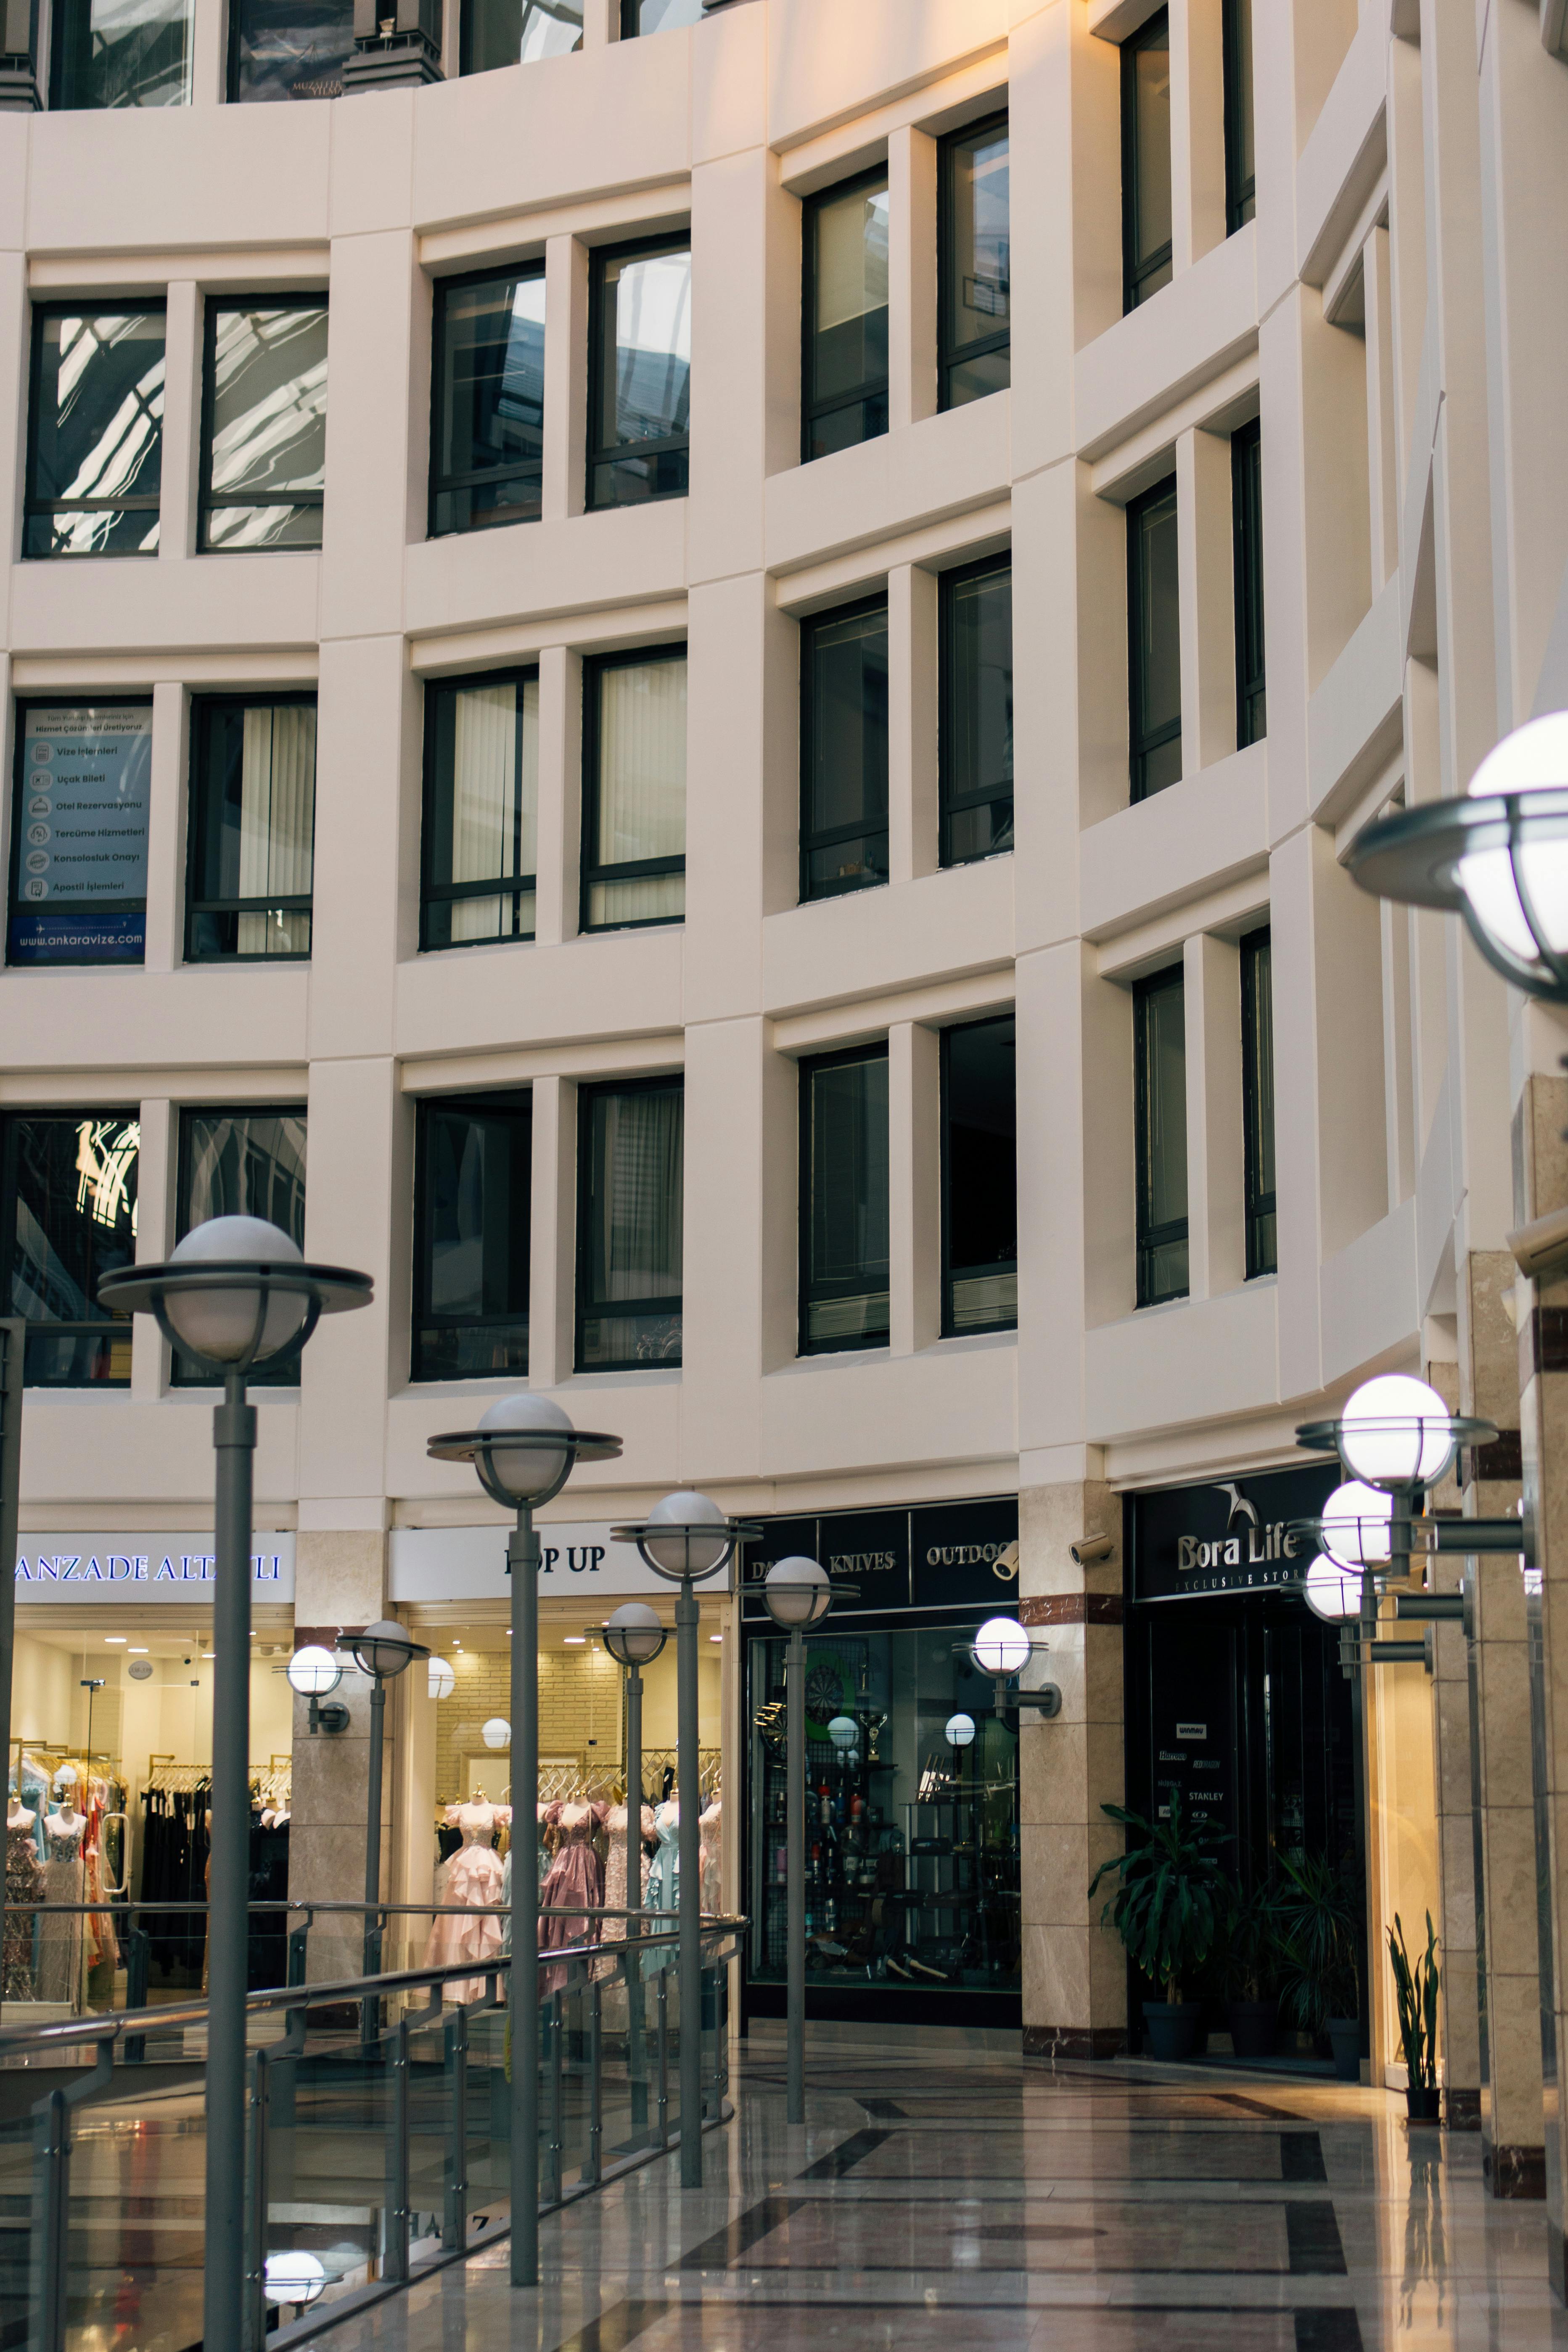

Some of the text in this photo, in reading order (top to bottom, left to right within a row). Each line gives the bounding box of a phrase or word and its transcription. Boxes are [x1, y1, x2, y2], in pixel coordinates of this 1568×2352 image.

[57, 774, 105, 785] Uçak Bileti
[77, 801, 142, 811] Rezervasyonu
[56, 827, 145, 838] Tercüme Hizmetleri
[54, 854, 109, 862] Konsolosluk
[112, 854, 140, 863] Onayı
[53, 881, 124, 893] Apostil İşlemleri
[20, 934, 142, 946] www.ankaravize.com
[1178, 1521, 1298, 1570] Bora Life
[567, 1546, 606, 1572] UP
[830, 1551, 896, 1574] KNIVES
[1175, 1574, 1253, 1592] EXCLUSIVE
[1189, 1792, 1224, 1801] STANLEY
